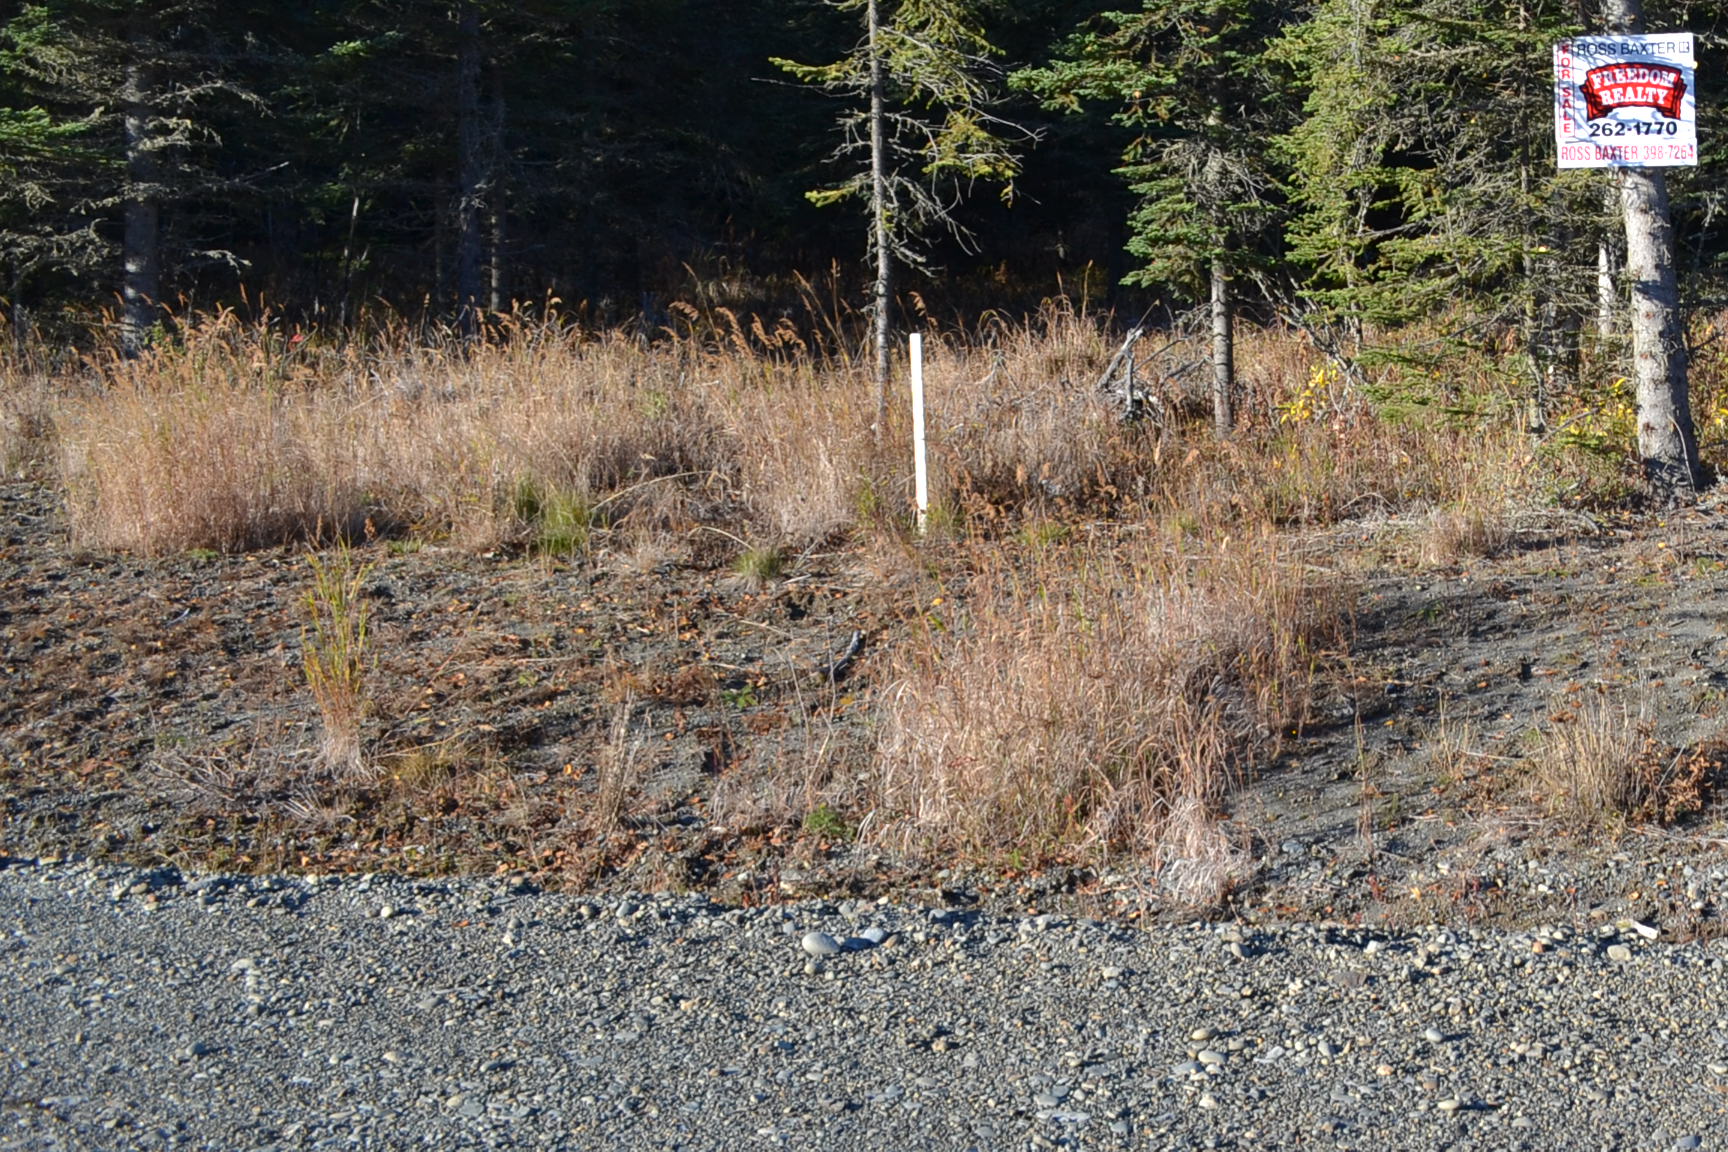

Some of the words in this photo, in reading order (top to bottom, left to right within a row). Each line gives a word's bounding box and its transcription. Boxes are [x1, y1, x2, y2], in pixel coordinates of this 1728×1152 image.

[1577, 43, 1616, 56] ROSS
[1621, 42, 1675, 55] BAXTER
[1560, 45, 1571, 79] FOR
[1591, 68, 1677, 89] FREEDOM
[1599, 86, 1669, 105] REALTY
[1562, 87, 1572, 133] SALE
[1561, 146, 1591, 160] ROSS
[1595, 146, 1638, 160] BAXTER
[1643, 145, 1694, 160] 398-7264
